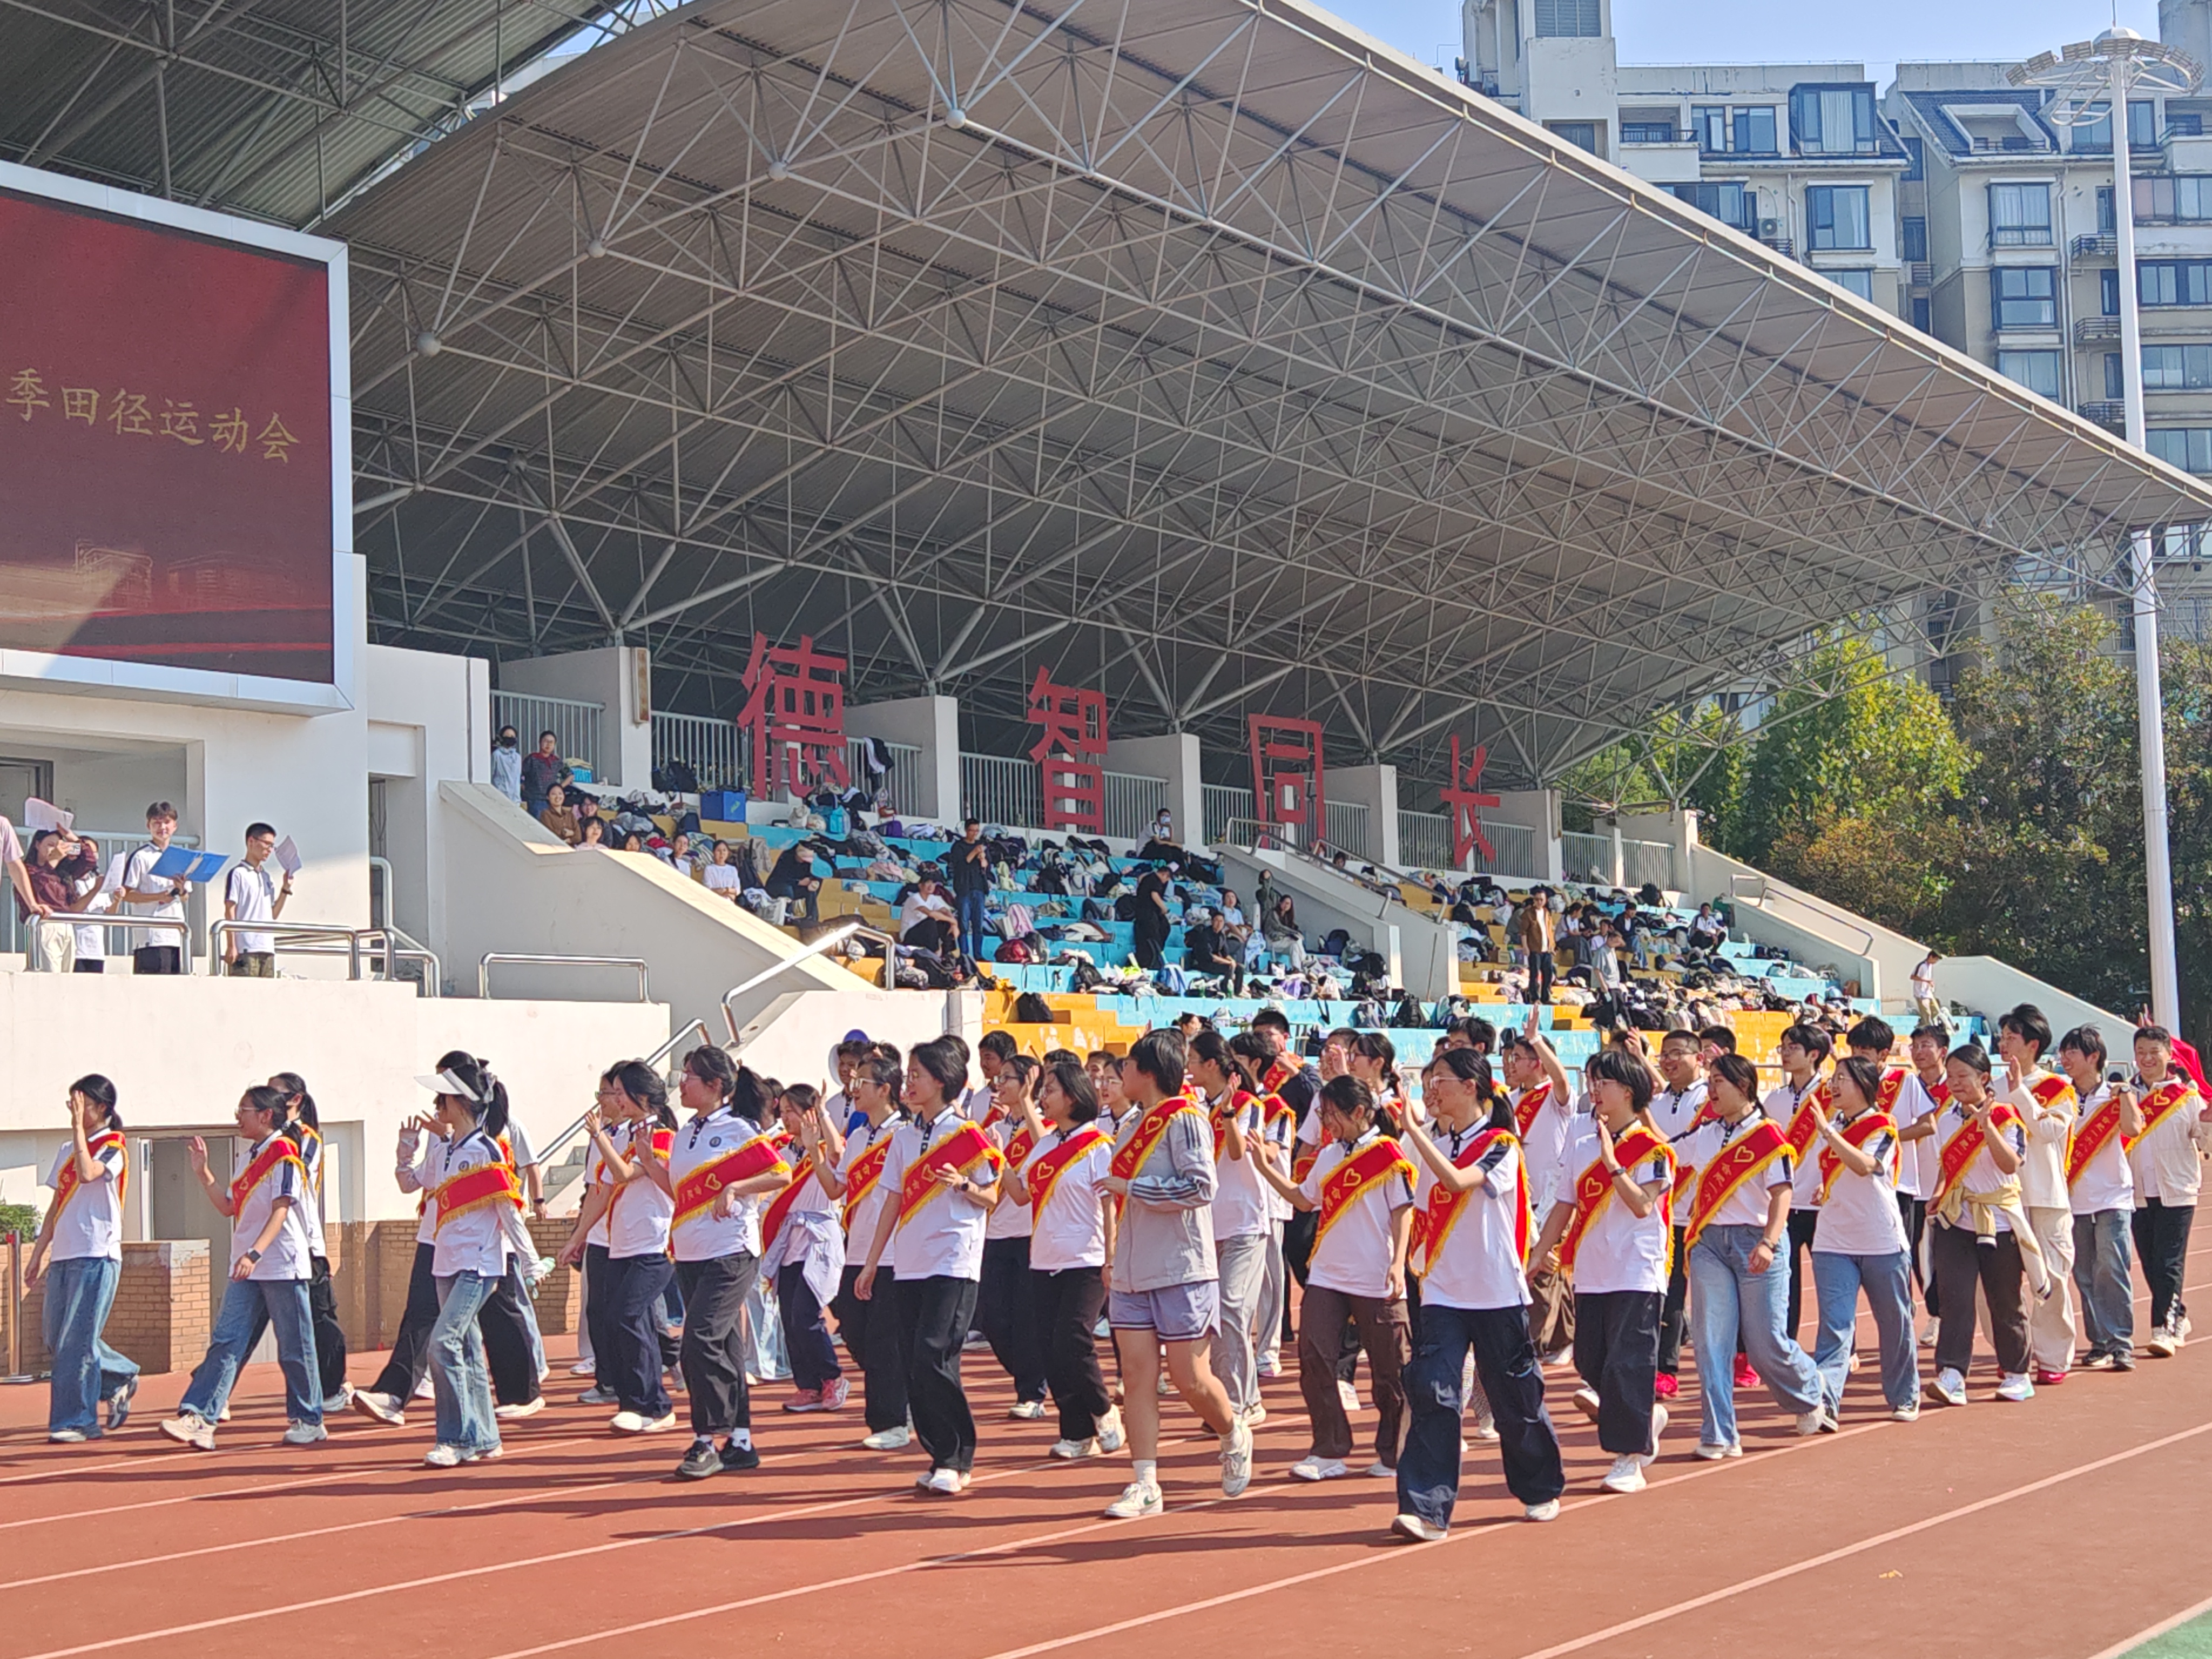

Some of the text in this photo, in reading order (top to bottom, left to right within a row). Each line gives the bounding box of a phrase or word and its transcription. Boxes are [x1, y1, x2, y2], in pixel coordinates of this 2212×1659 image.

[6, 368, 300, 463] 季田径运动会
